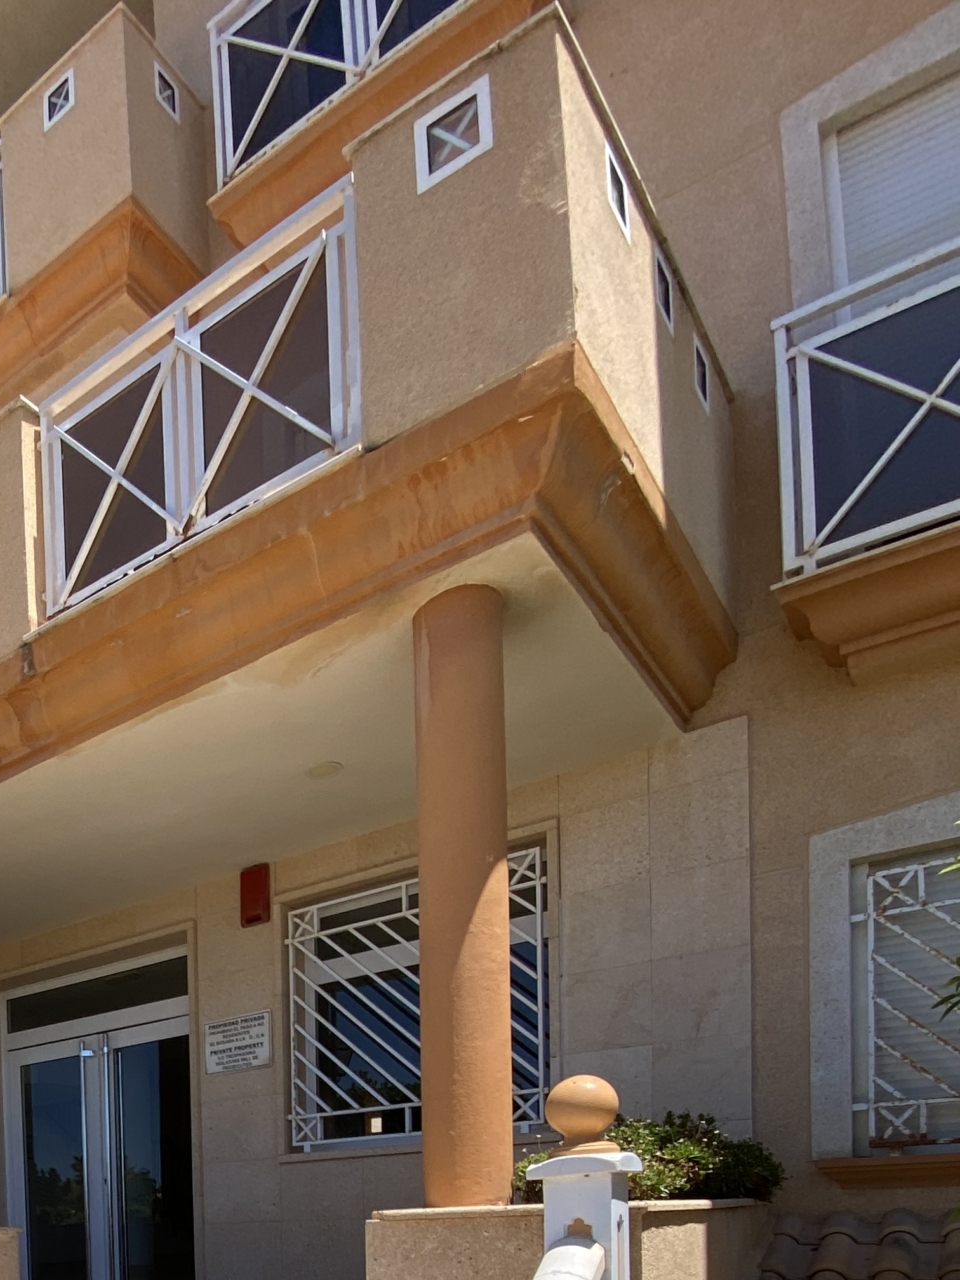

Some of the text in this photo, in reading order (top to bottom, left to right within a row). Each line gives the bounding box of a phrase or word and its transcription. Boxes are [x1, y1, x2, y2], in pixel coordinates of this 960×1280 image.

[208, 1014, 264, 1030] PROPIEDAD PRIVADA
[210, 1042, 264, 1056] PRIVATE PROPERTY
